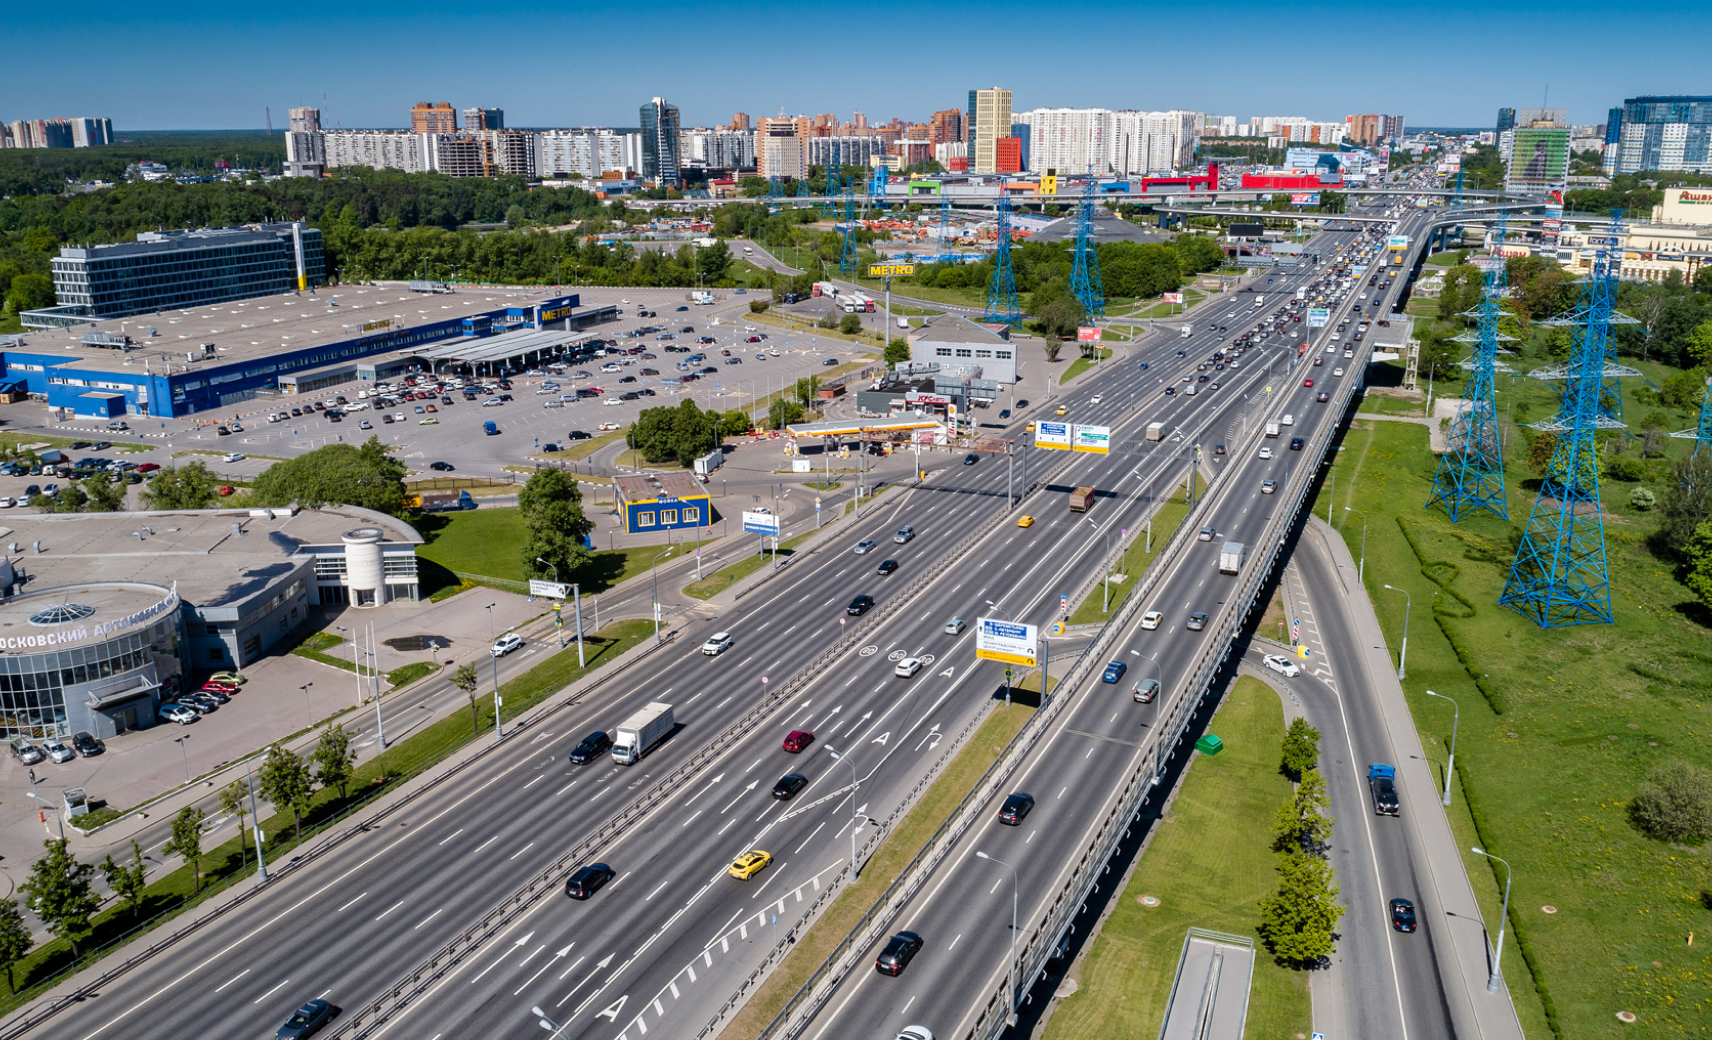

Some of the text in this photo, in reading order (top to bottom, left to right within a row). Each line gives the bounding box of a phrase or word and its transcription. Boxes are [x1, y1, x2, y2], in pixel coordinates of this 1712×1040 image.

[870, 265, 914, 275] METRO
[541, 306, 571, 322] METRO
[363, 319, 390, 332] METRO
